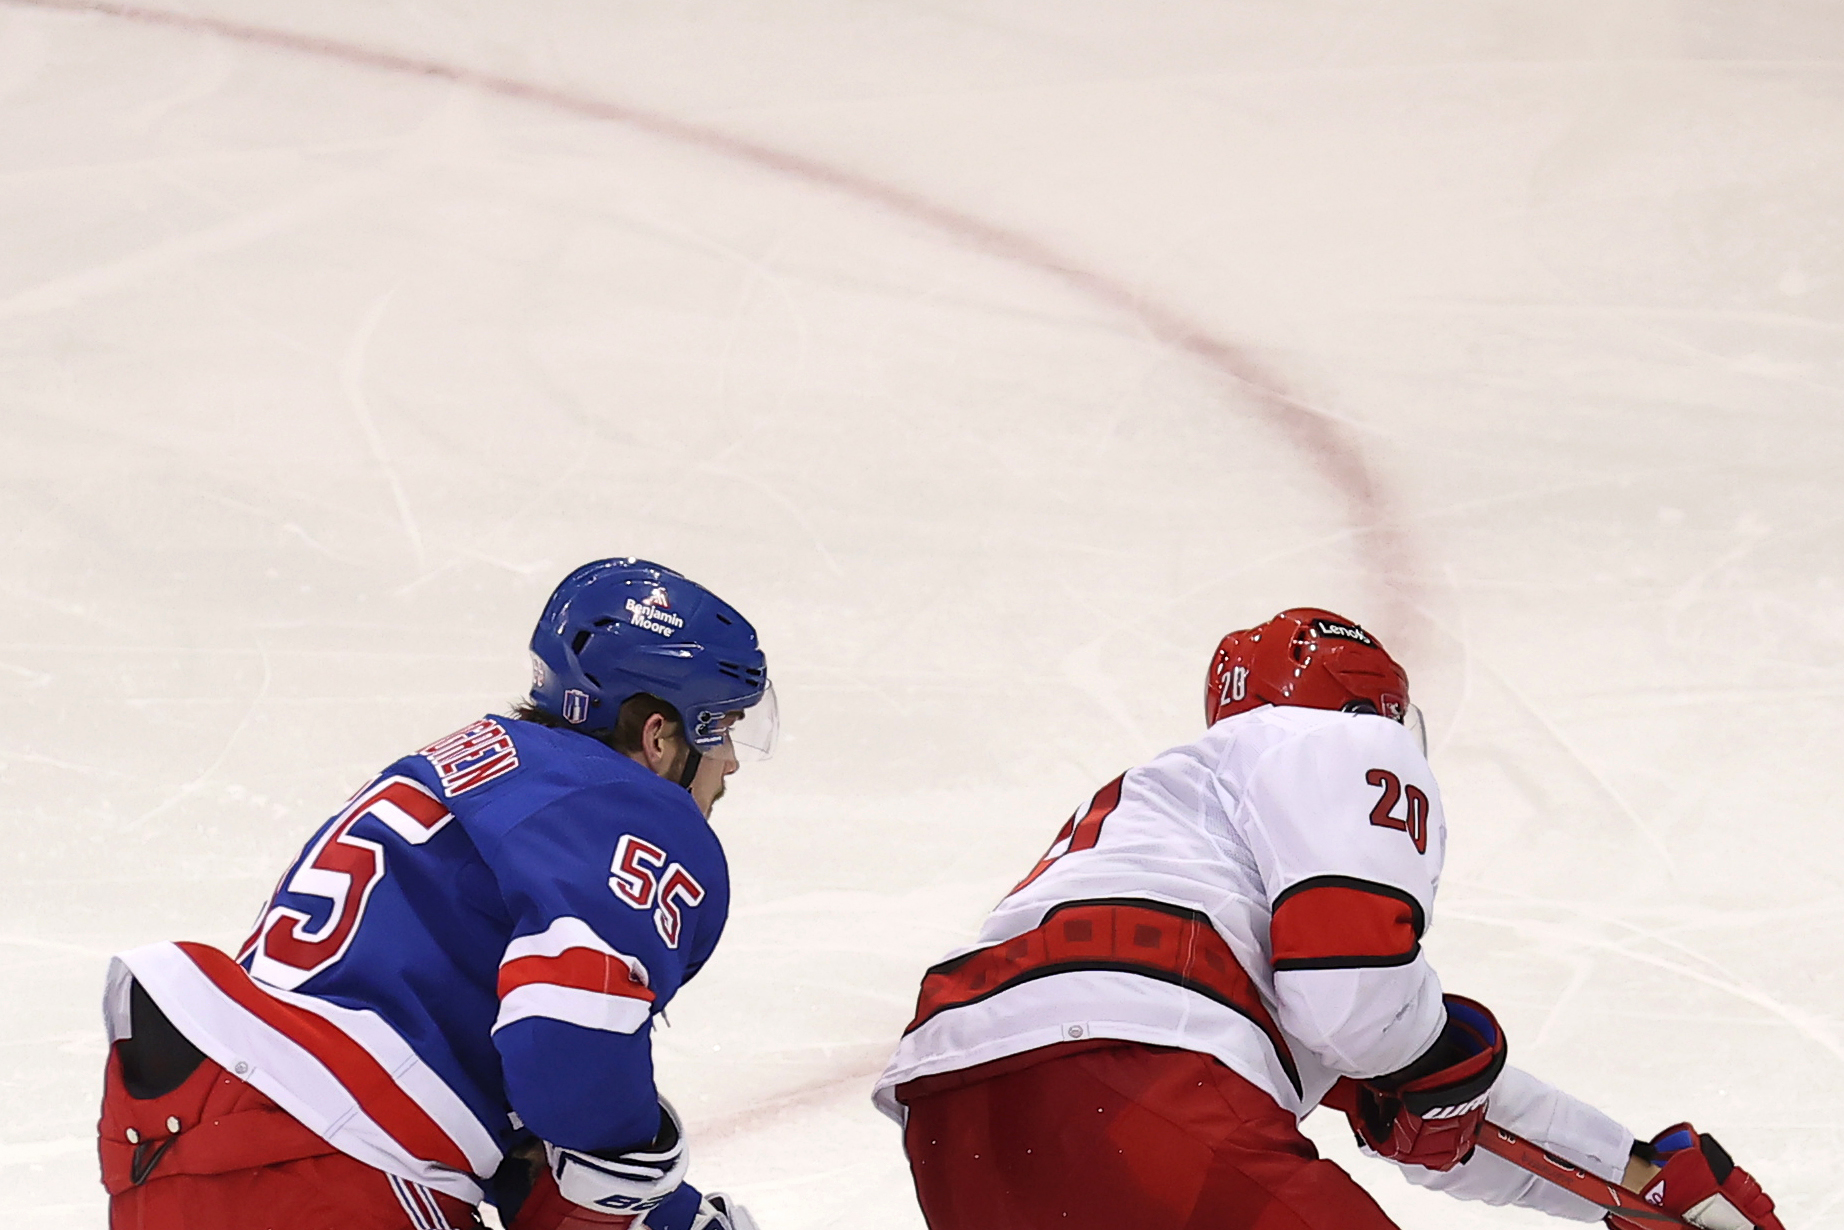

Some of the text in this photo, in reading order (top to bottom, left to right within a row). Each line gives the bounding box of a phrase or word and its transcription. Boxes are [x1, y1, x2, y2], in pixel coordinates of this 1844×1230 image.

[626, 598, 684, 628] Benjamin
[1220, 665, 1248, 706] 20
[413, 718, 520, 798] GREN
[1365, 768, 1429, 855] 20
[234, 774, 457, 992] 5
[608, 833, 706, 949] 55
